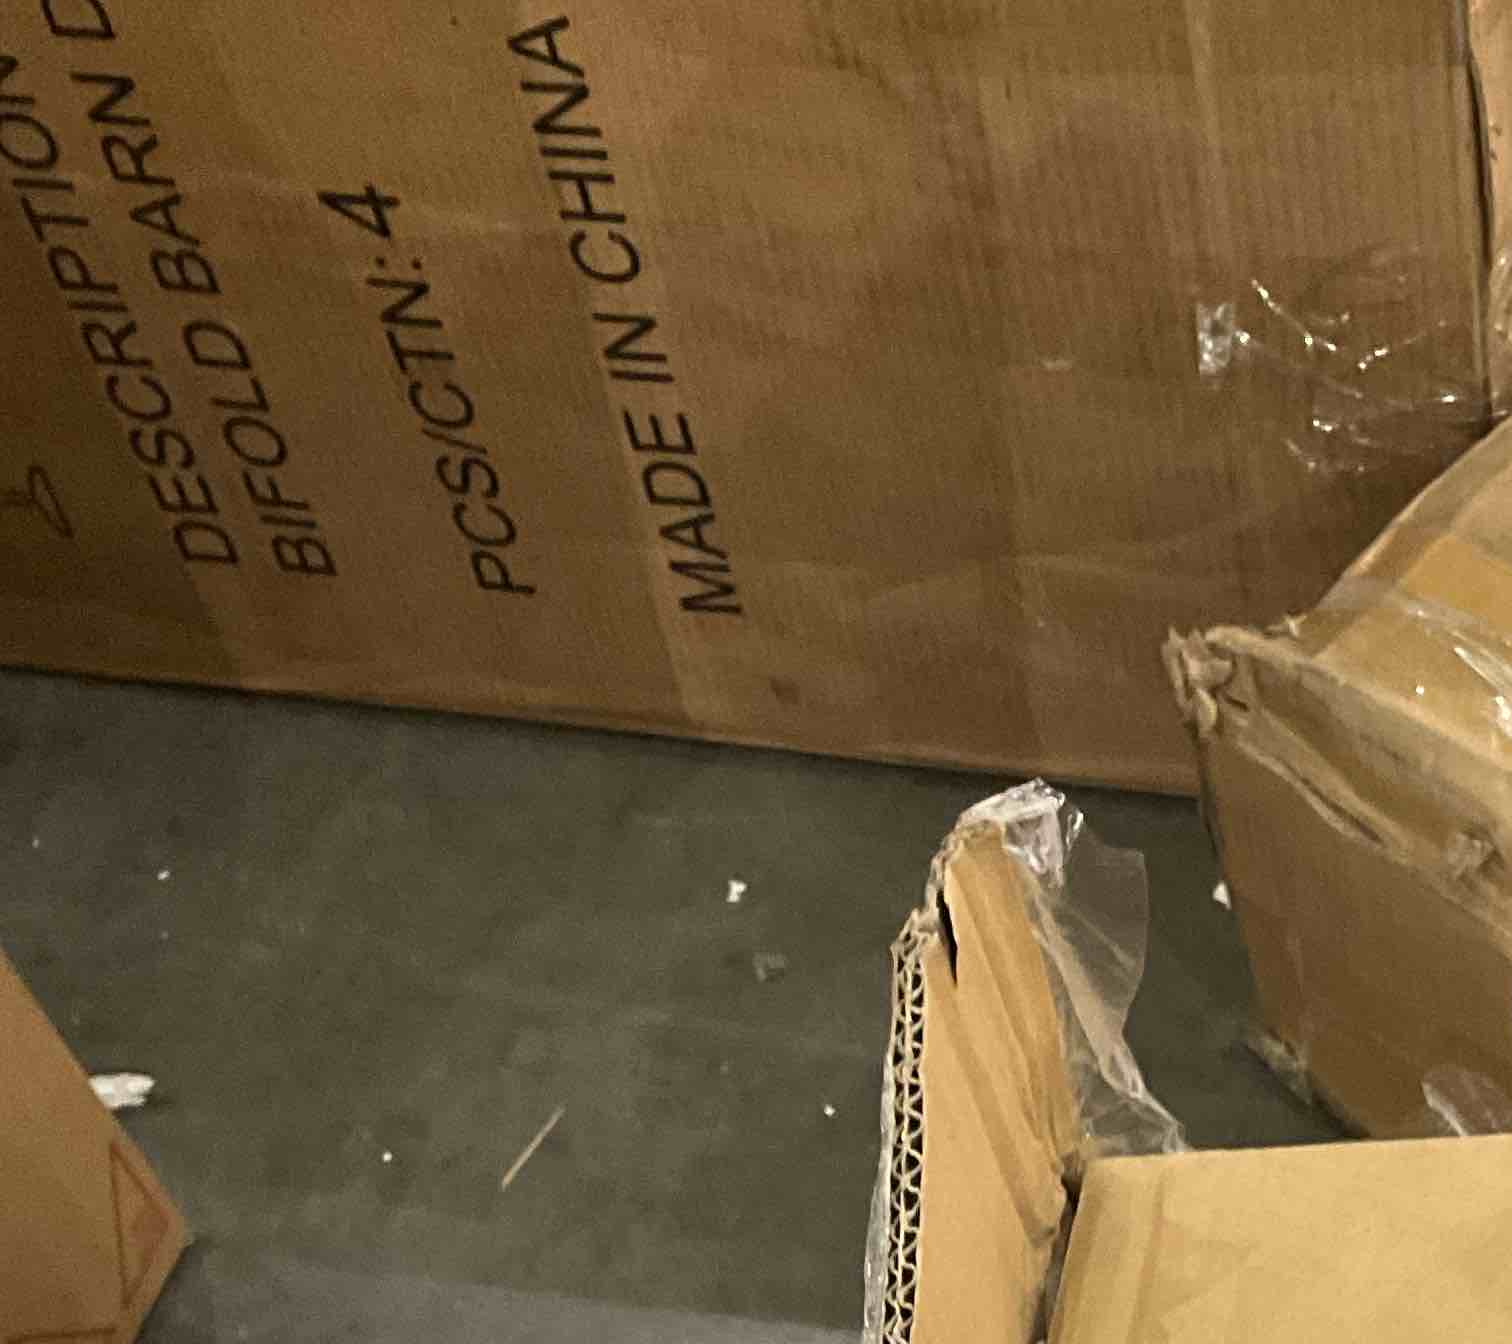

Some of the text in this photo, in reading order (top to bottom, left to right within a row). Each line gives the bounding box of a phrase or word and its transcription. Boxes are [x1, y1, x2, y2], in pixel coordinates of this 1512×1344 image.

[69, 71, 222, 296] BARN
[507, 14, 744, 617] MADE IN CHINA
[181, 319, 338, 578] BIFOLD
[316, 183, 538, 596] PCS/CTN: 4
